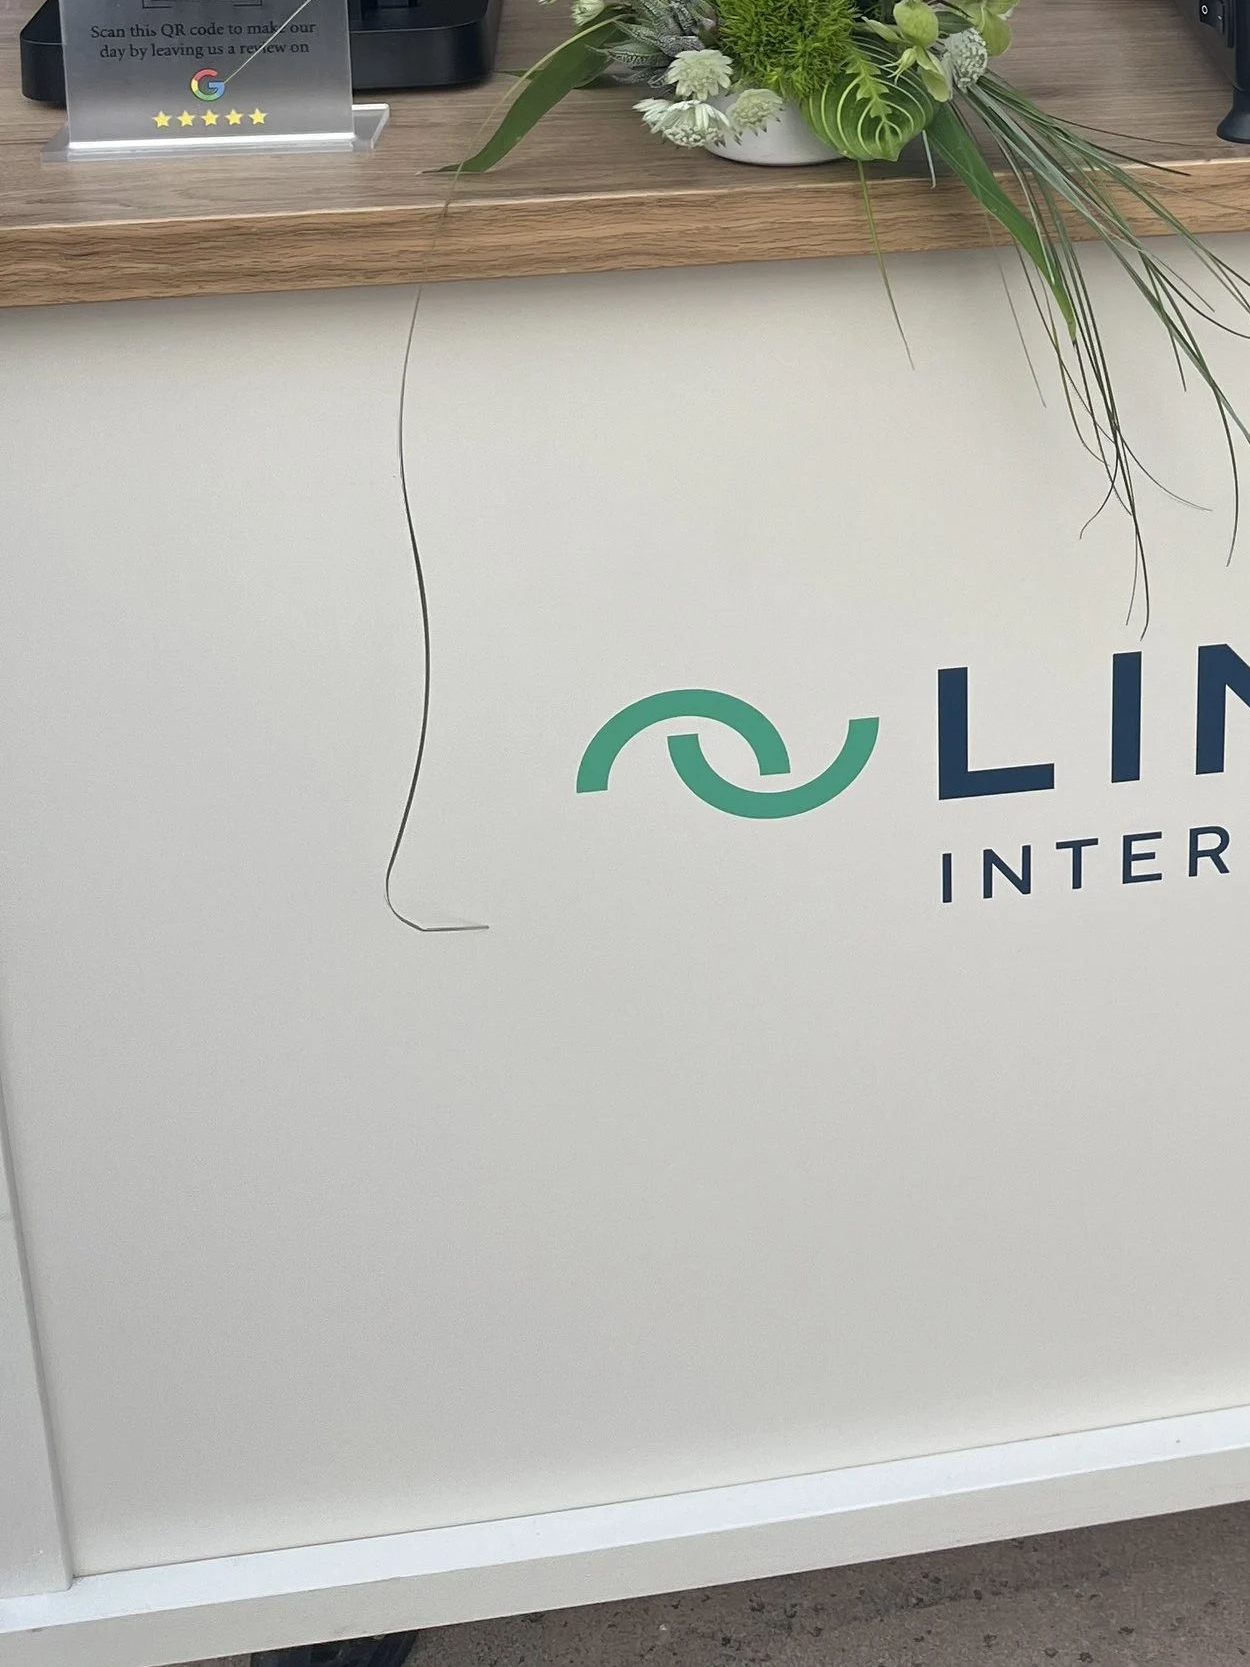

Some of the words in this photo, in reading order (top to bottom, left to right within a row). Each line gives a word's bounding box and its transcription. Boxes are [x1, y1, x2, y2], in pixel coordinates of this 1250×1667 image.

[91, 25, 126, 39] Scan
[129, 24, 157, 38] this
[160, 23, 187, 39] QR
[189, 22, 225, 36] code
[228, 24, 243, 35] to
[290, 23, 317, 34] our
[100, 44, 126, 61] day
[130, 44, 149, 61] by
[151, 43, 204, 59] leaving
[207, 45, 224, 56] us
[227, 45, 236, 55] a
[239, 43, 287, 55] review
[290, 43, 310, 54] on
